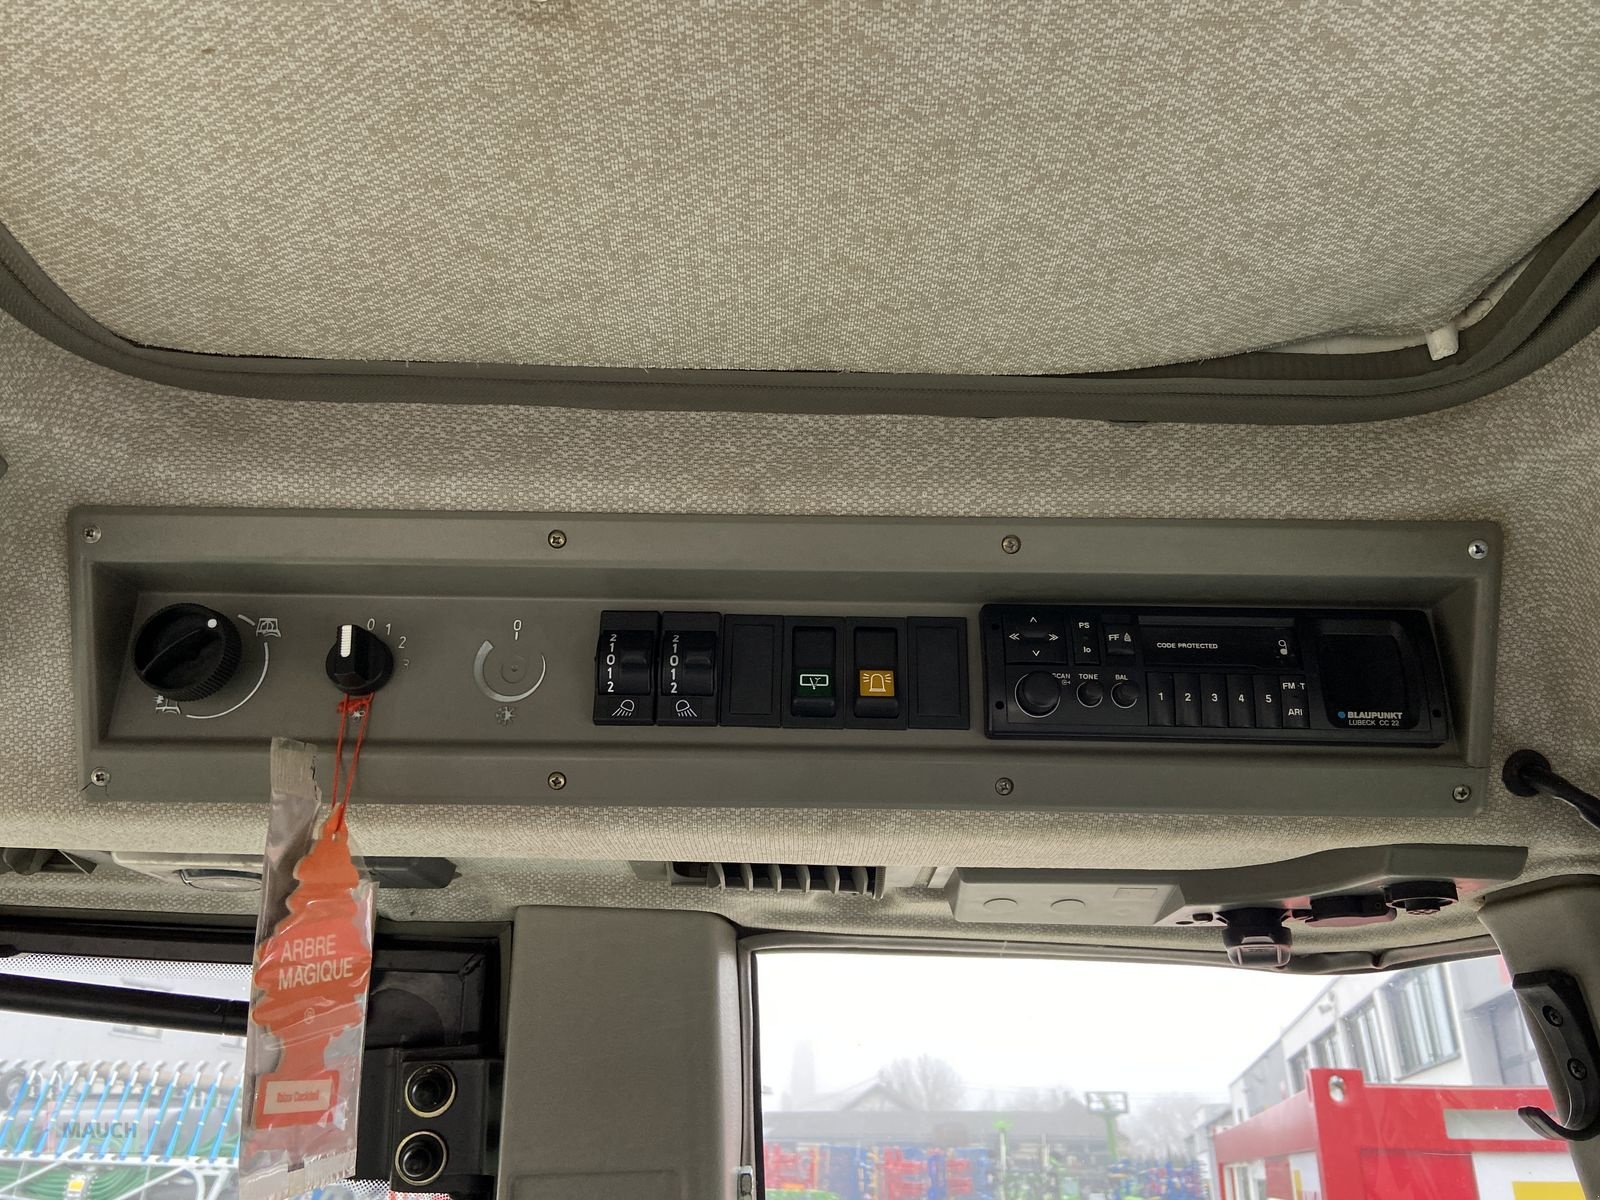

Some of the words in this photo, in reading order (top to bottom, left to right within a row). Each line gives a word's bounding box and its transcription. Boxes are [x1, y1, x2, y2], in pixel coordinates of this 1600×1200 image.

[1078, 621, 1090, 629] PS
[366, 617, 376, 631] 0
[385, 623, 392, 636] 1
[398, 635, 407, 649] 2
[1108, 633, 1120, 641] FF
[609, 633, 617, 645] 2
[672, 634, 680, 645] 2
[609, 642, 615, 653] 1
[672, 643, 678, 654] 1
[1177, 642, 1219, 650] PROTECTED
[606, 653, 616, 666] 0
[669, 654, 679, 667] 0
[606, 667, 613, 680] 1
[670, 668, 677, 681] 1
[607, 681, 615, 693] 2
[670, 682, 678, 694] 2
[1282, 682, 1296, 690] FM
[1157, 692, 1164, 701] 1
[1184, 692, 1192, 702] 2
[1211, 693, 1219, 702] 3
[1238, 693, 1245, 703] 4
[1265, 694, 1272, 704] 5
[1287, 708, 1303, 717] ARI
[1347, 711, 1403, 720] BLAUPUNKT
[1378, 719, 1390, 727] CC
[280, 934, 337, 963] ARBRE
[278, 956, 354, 991] MAGIQUE
